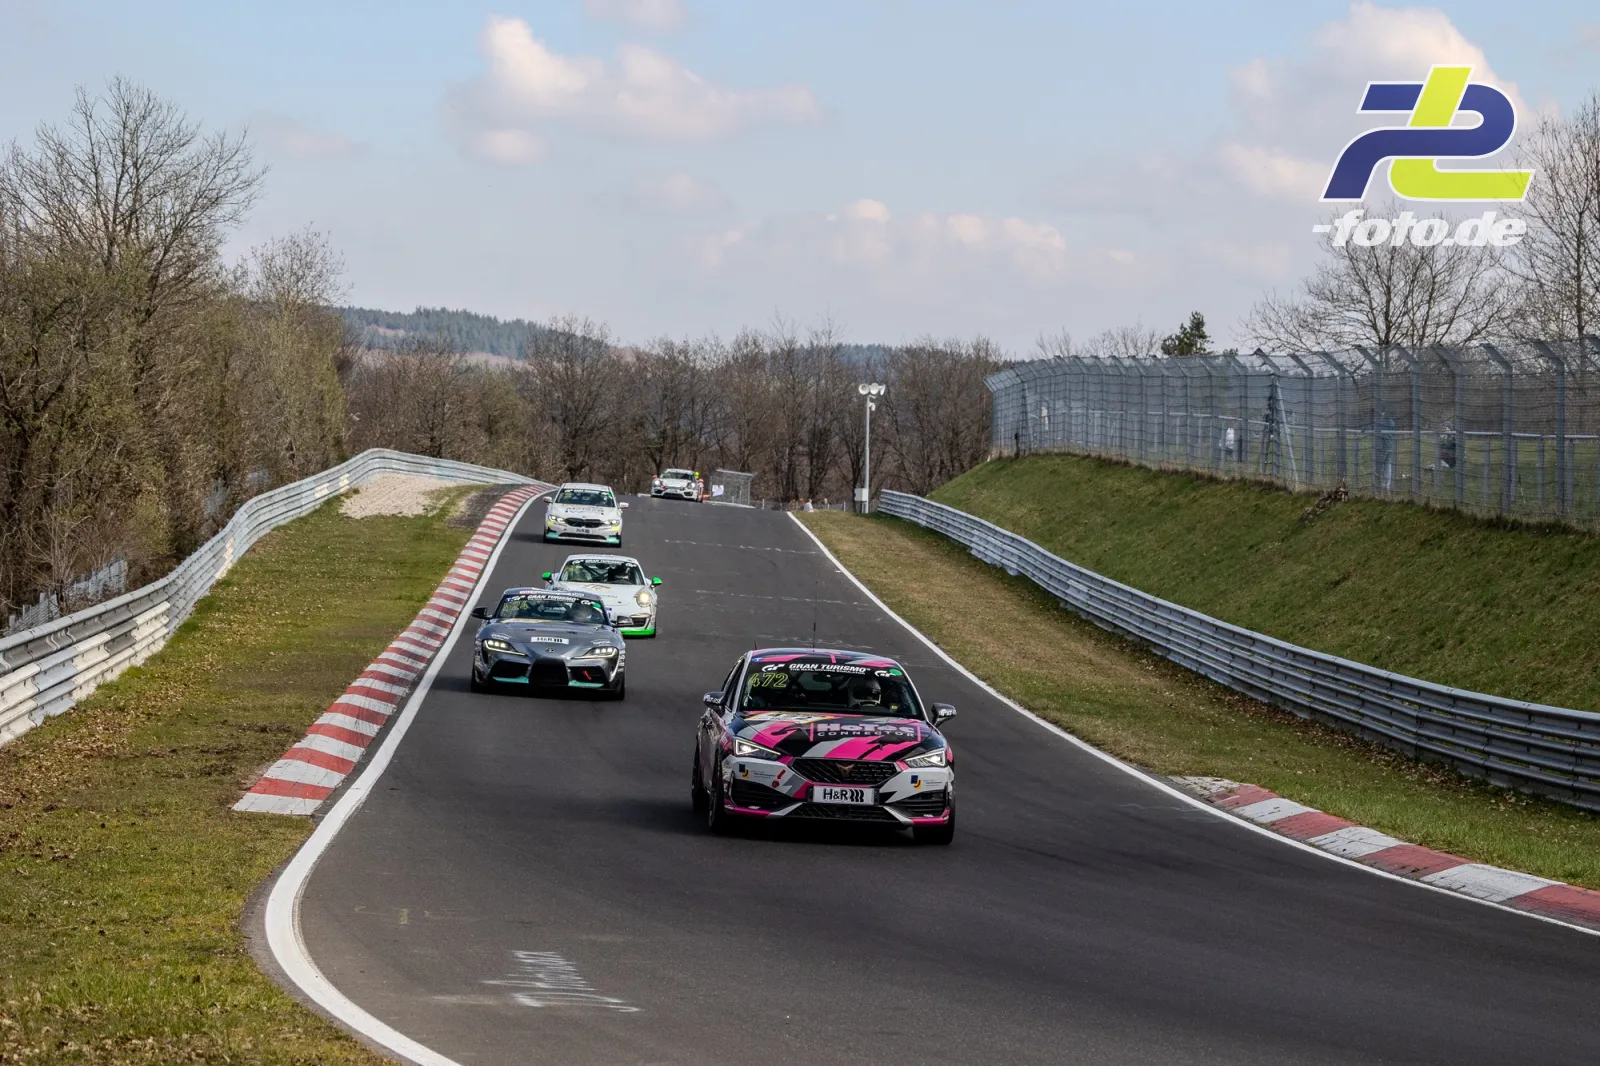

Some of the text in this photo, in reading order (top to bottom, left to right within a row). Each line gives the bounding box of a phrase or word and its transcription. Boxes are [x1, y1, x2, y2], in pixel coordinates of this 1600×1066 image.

[820, 664, 867, 672] TURISMO
[747, 672, 788, 688] 472
[823, 788, 848, 801] H&R
